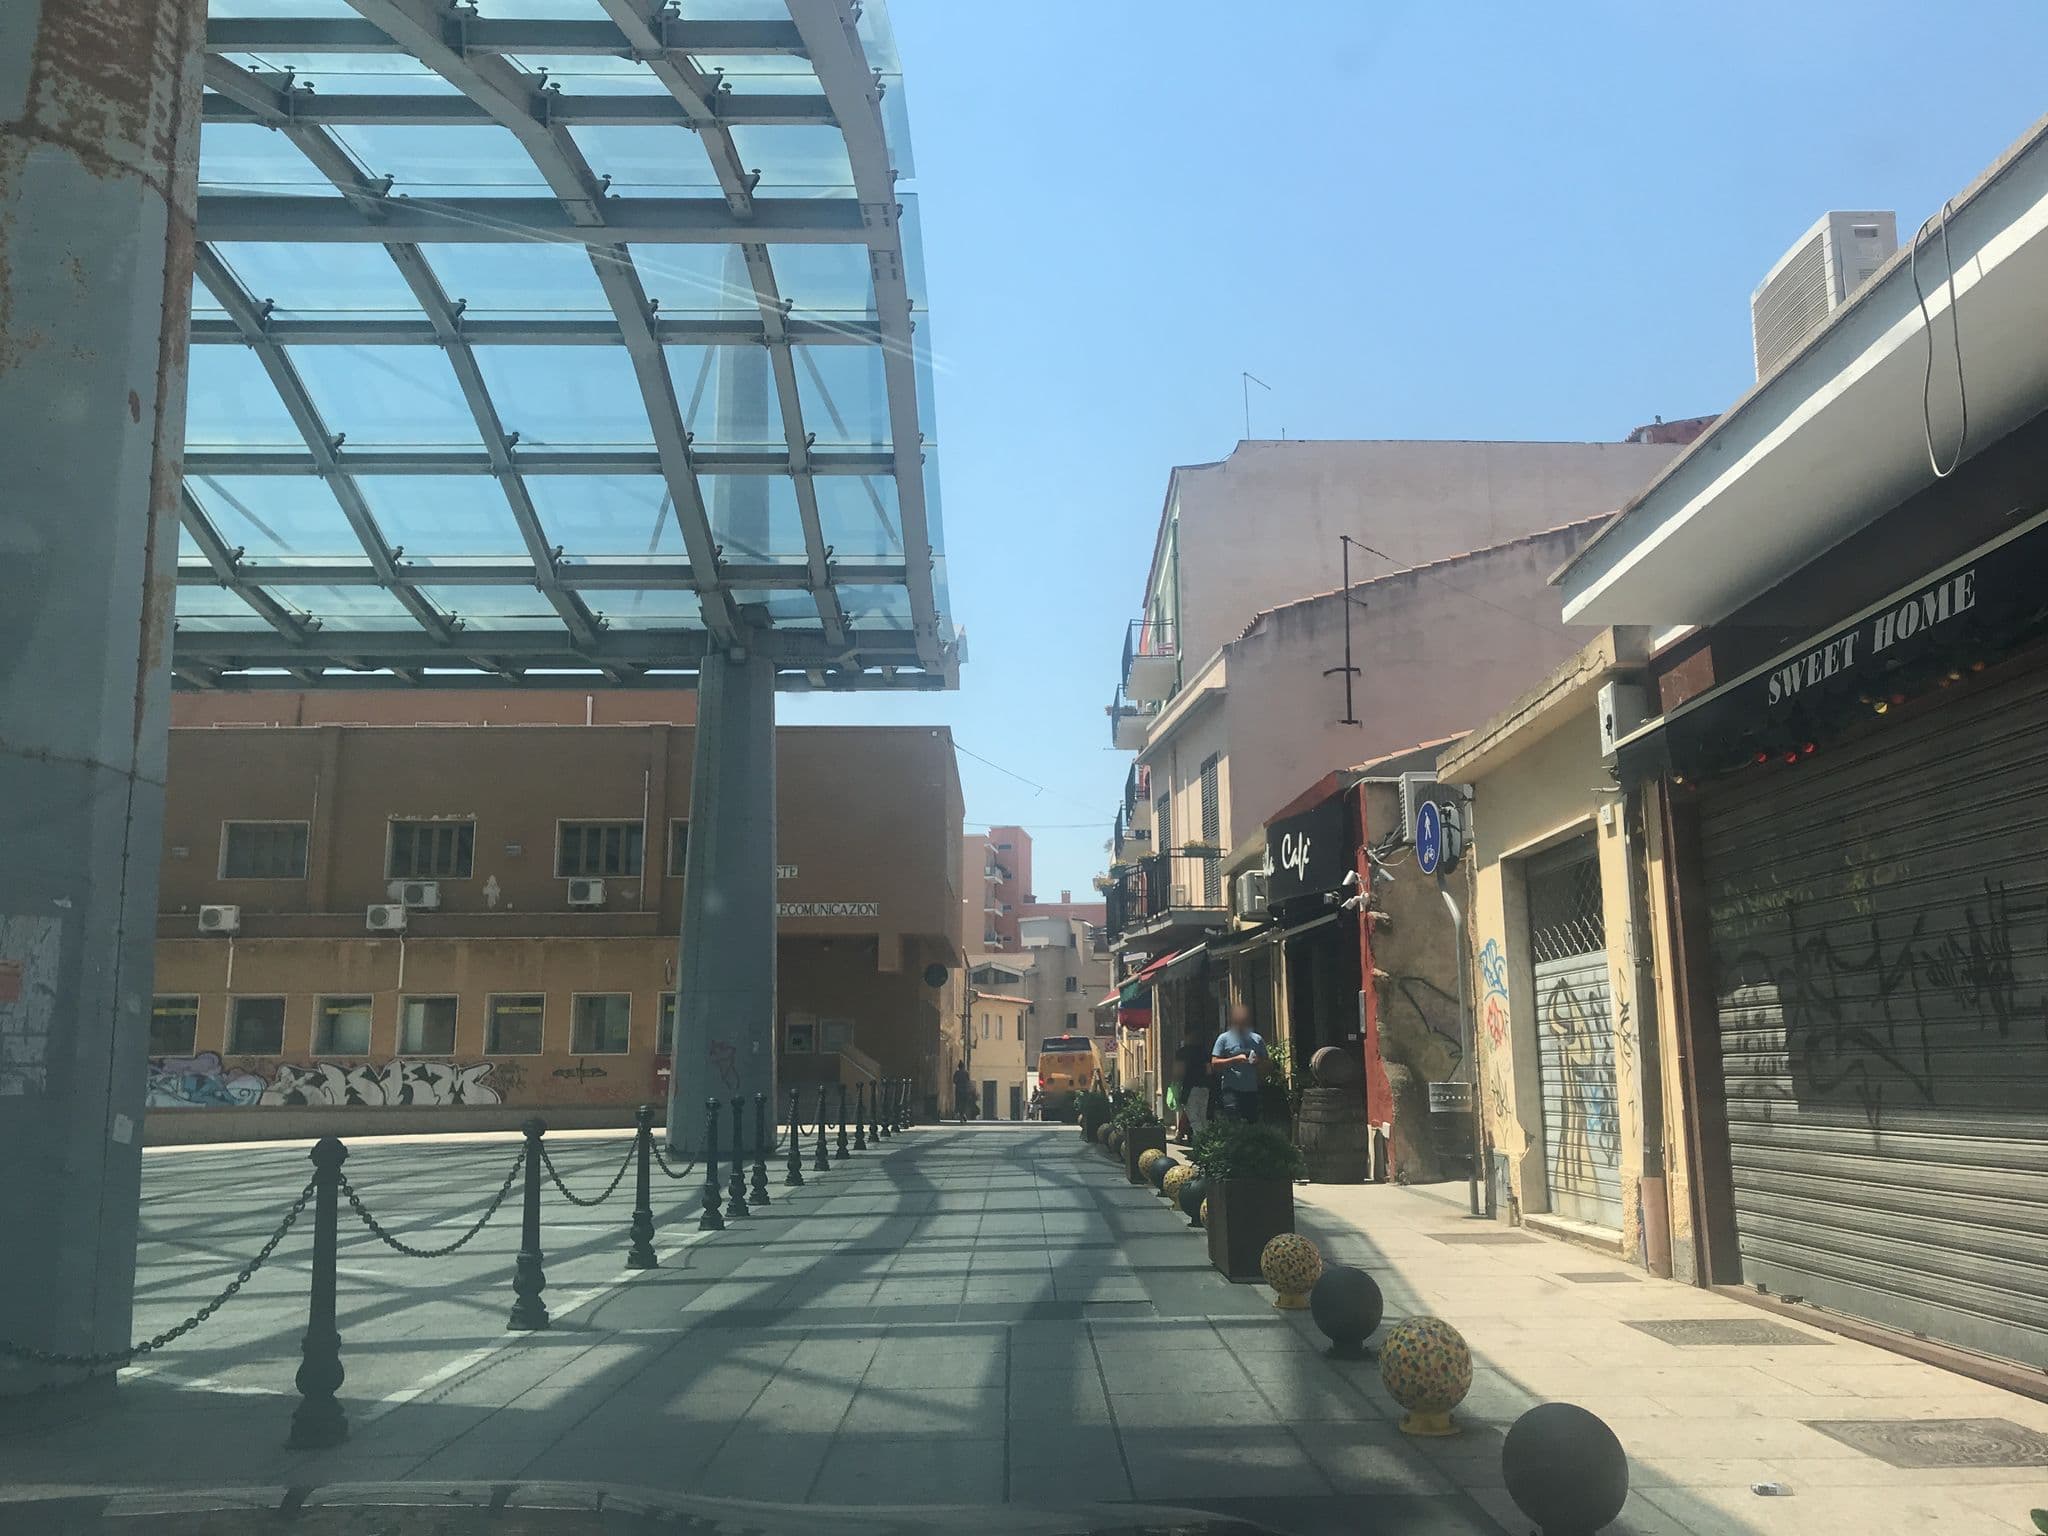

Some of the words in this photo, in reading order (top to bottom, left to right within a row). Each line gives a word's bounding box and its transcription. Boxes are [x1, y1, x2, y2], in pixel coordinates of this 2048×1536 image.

[1768, 631, 1860, 706] SWEET
[1872, 569, 1976, 654] HOME
[776, 903, 880, 916] ECOMUNICAZIONI
